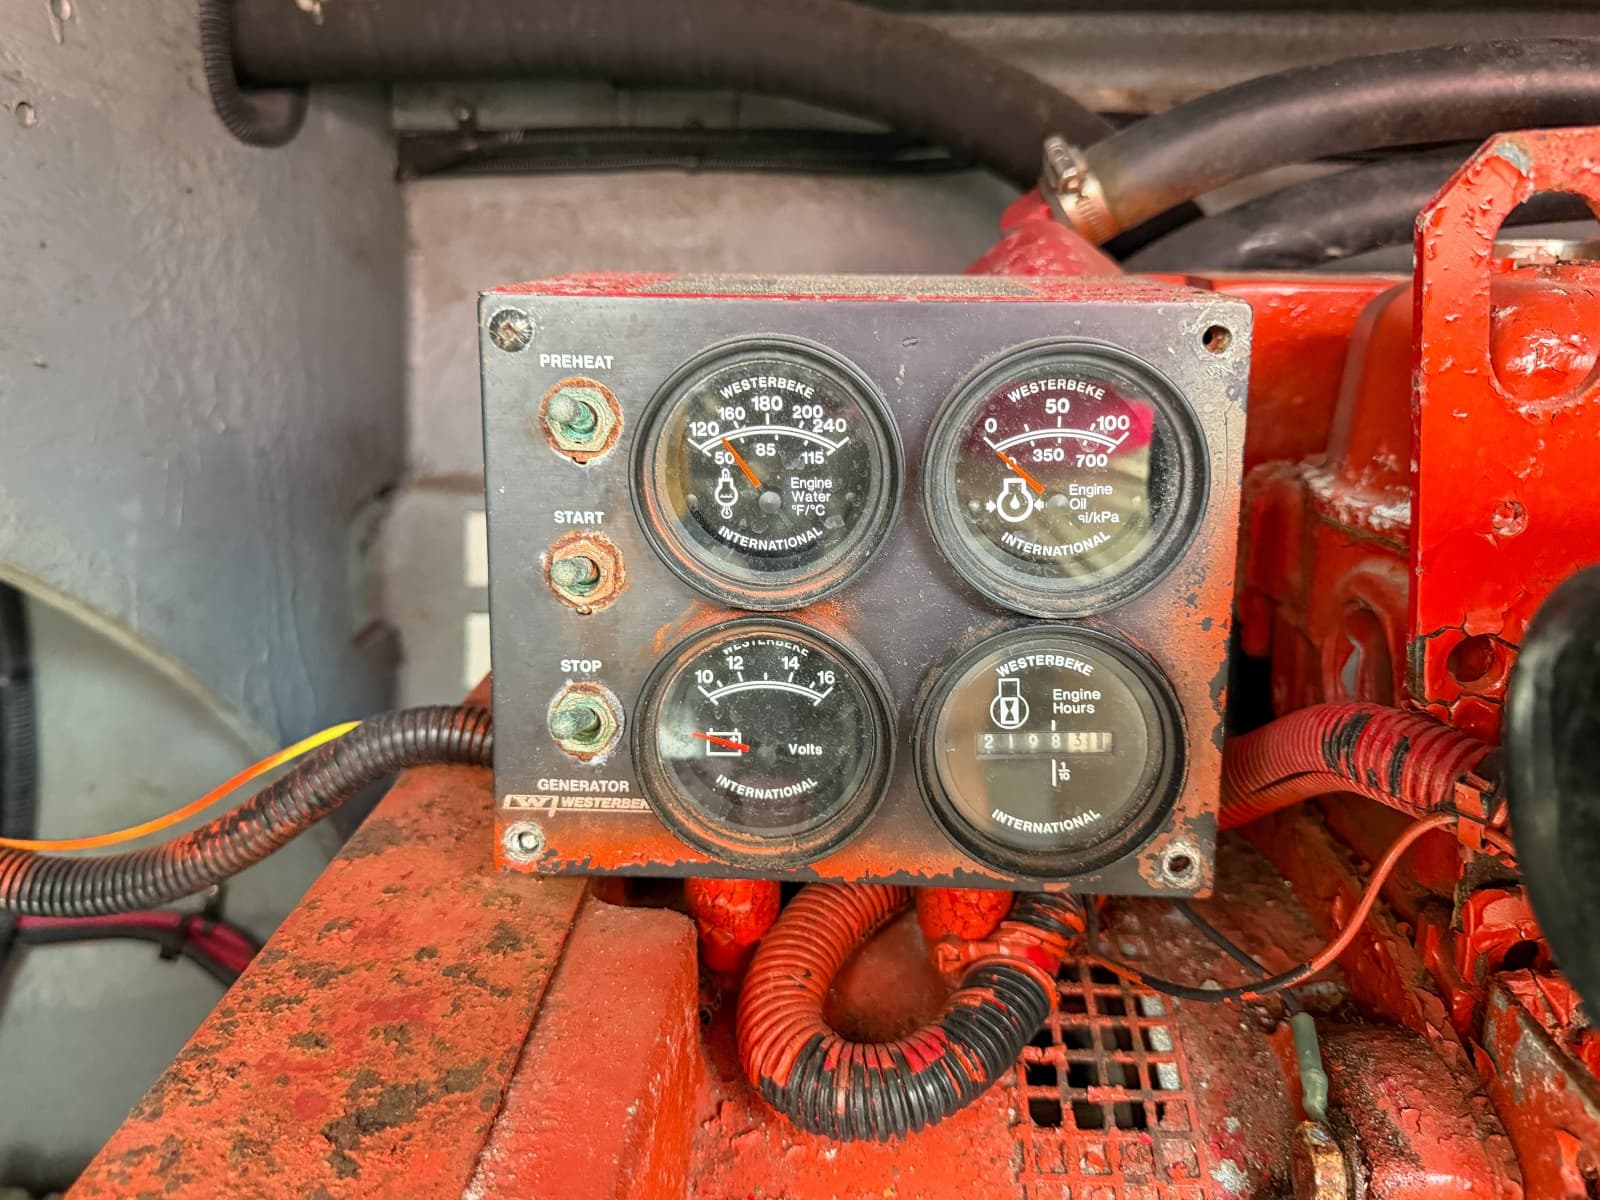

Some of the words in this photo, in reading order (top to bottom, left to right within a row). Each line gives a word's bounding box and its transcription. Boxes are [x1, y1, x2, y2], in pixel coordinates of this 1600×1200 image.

[539, 354, 614, 370] PREHEAT
[720, 376, 815, 399] WESTERBEKE
[1007, 378, 1106, 403] WESTERBEKE
[751, 396, 783, 411] 180
[1045, 398, 1070, 414] 50
[719, 406, 746, 421] 160
[792, 405, 823, 419] 200
[689, 421, 719, 437] 120
[812, 418, 847, 433] 240
[984, 418, 998, 433] 0
[1097, 415, 1130, 431] 100
[755, 443, 776, 456] 85
[1032, 449, 1065, 462] 350
[714, 452, 735, 465] 50
[802, 451, 825, 465] 115
[1076, 454, 1108, 468] 700
[790, 477, 833, 490] Engine
[1069, 483, 1113, 498] Engine
[791, 491, 832, 502] Water
[1069, 497, 1087, 510] Oil
[554, 511, 605, 524] START
[791, 504, 826, 517] °F/°C
[718, 526, 823, 550] INTERNATIONAL
[1001, 531, 1111, 556] INTERNATIONAL
[560, 659, 603, 673] STOP
[726, 656, 744, 670] 12
[781, 656, 800, 670] 14
[995, 655, 1094, 677] WESTERBEKE
[695, 670, 714, 683] 10
[816, 671, 836, 684] 16
[1052, 689, 1101, 702] Engine
[1052, 702, 1096, 714] Hours
[788, 743, 823, 755] Volts
[537, 779, 630, 793] GENERATOR
[716, 774, 818, 799] INTERNATIONAL
[991, 808, 1102, 834] INTERNATIONAL
